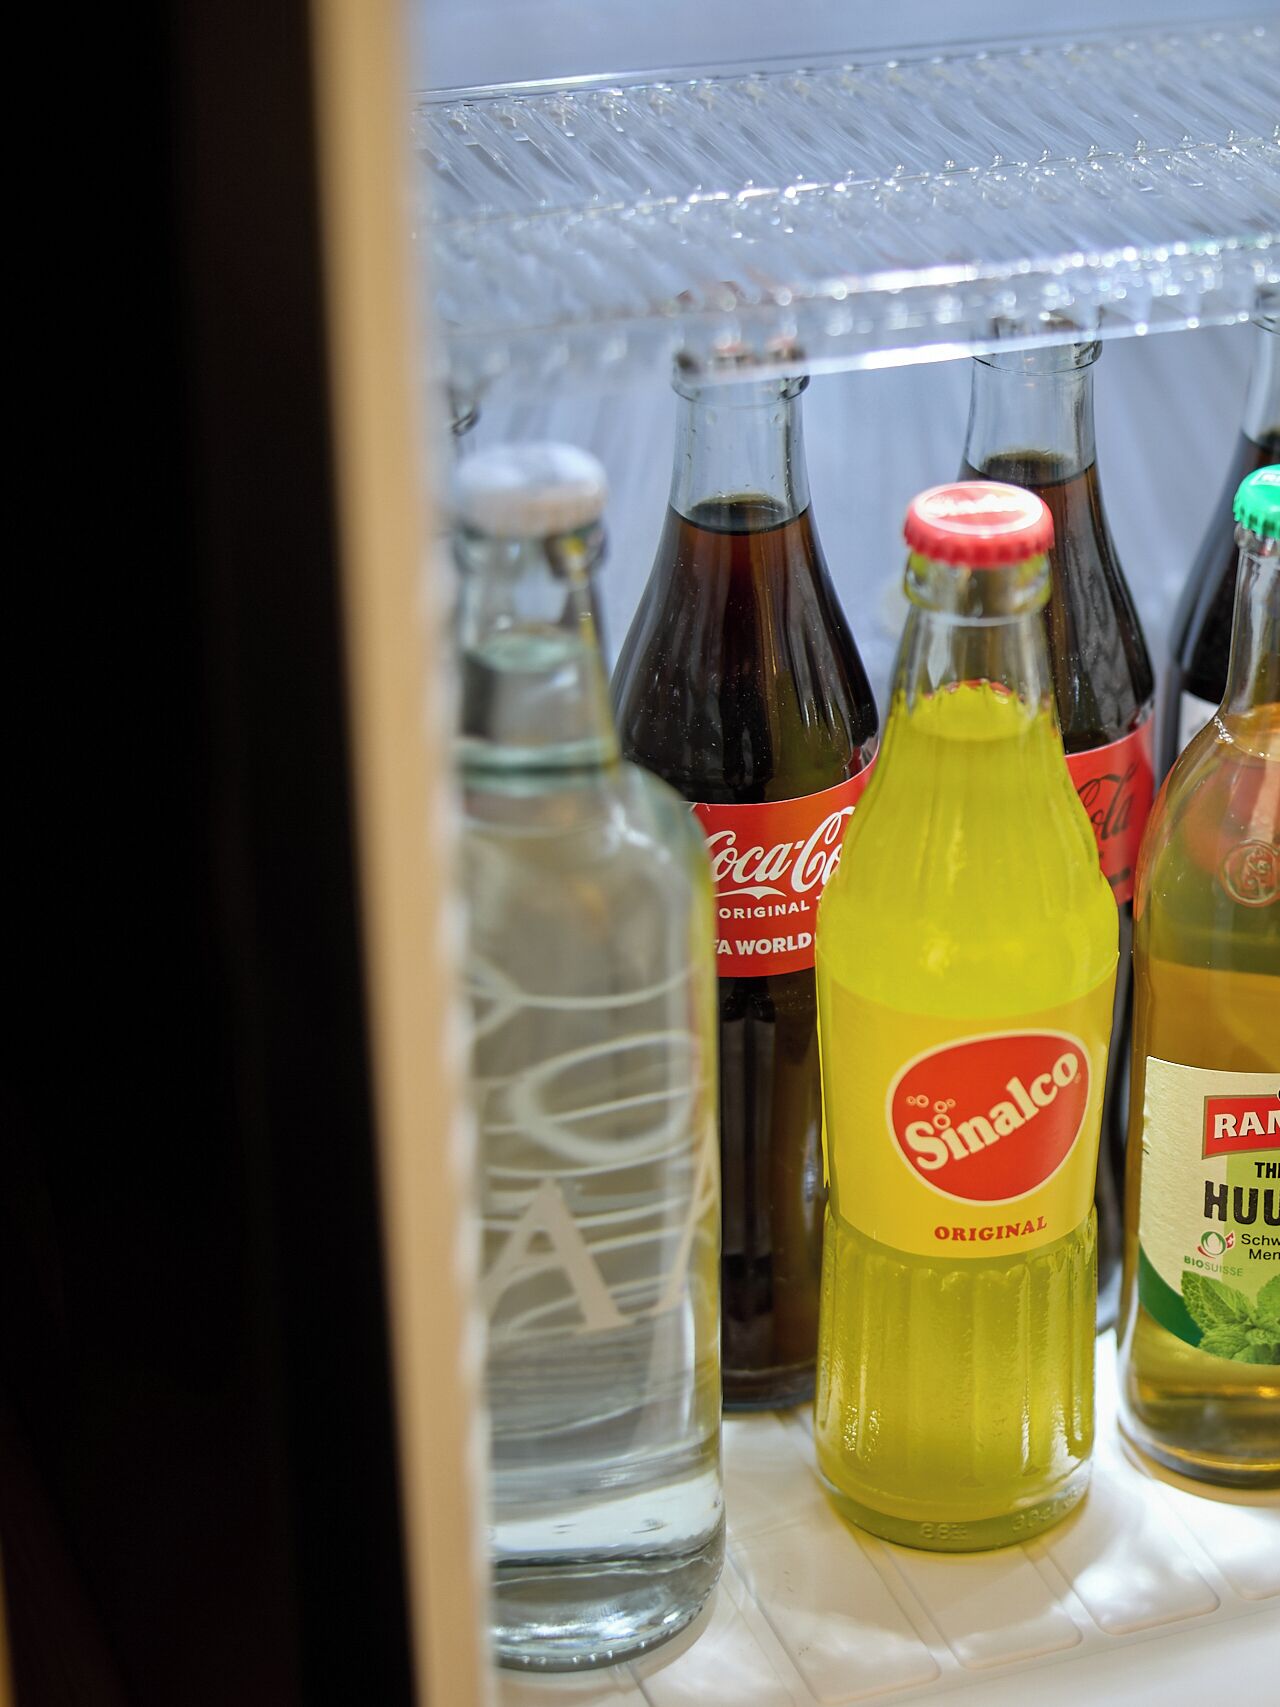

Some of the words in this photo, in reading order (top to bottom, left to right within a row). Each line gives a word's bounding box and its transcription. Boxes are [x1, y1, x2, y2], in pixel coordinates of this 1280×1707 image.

[718, 899, 811, 919] ORIGINAL
[735, 932, 813, 956] WORLD
[904, 1052, 1080, 1171] Sinalco
[933, 1215, 1048, 1242] ORIGINAL
